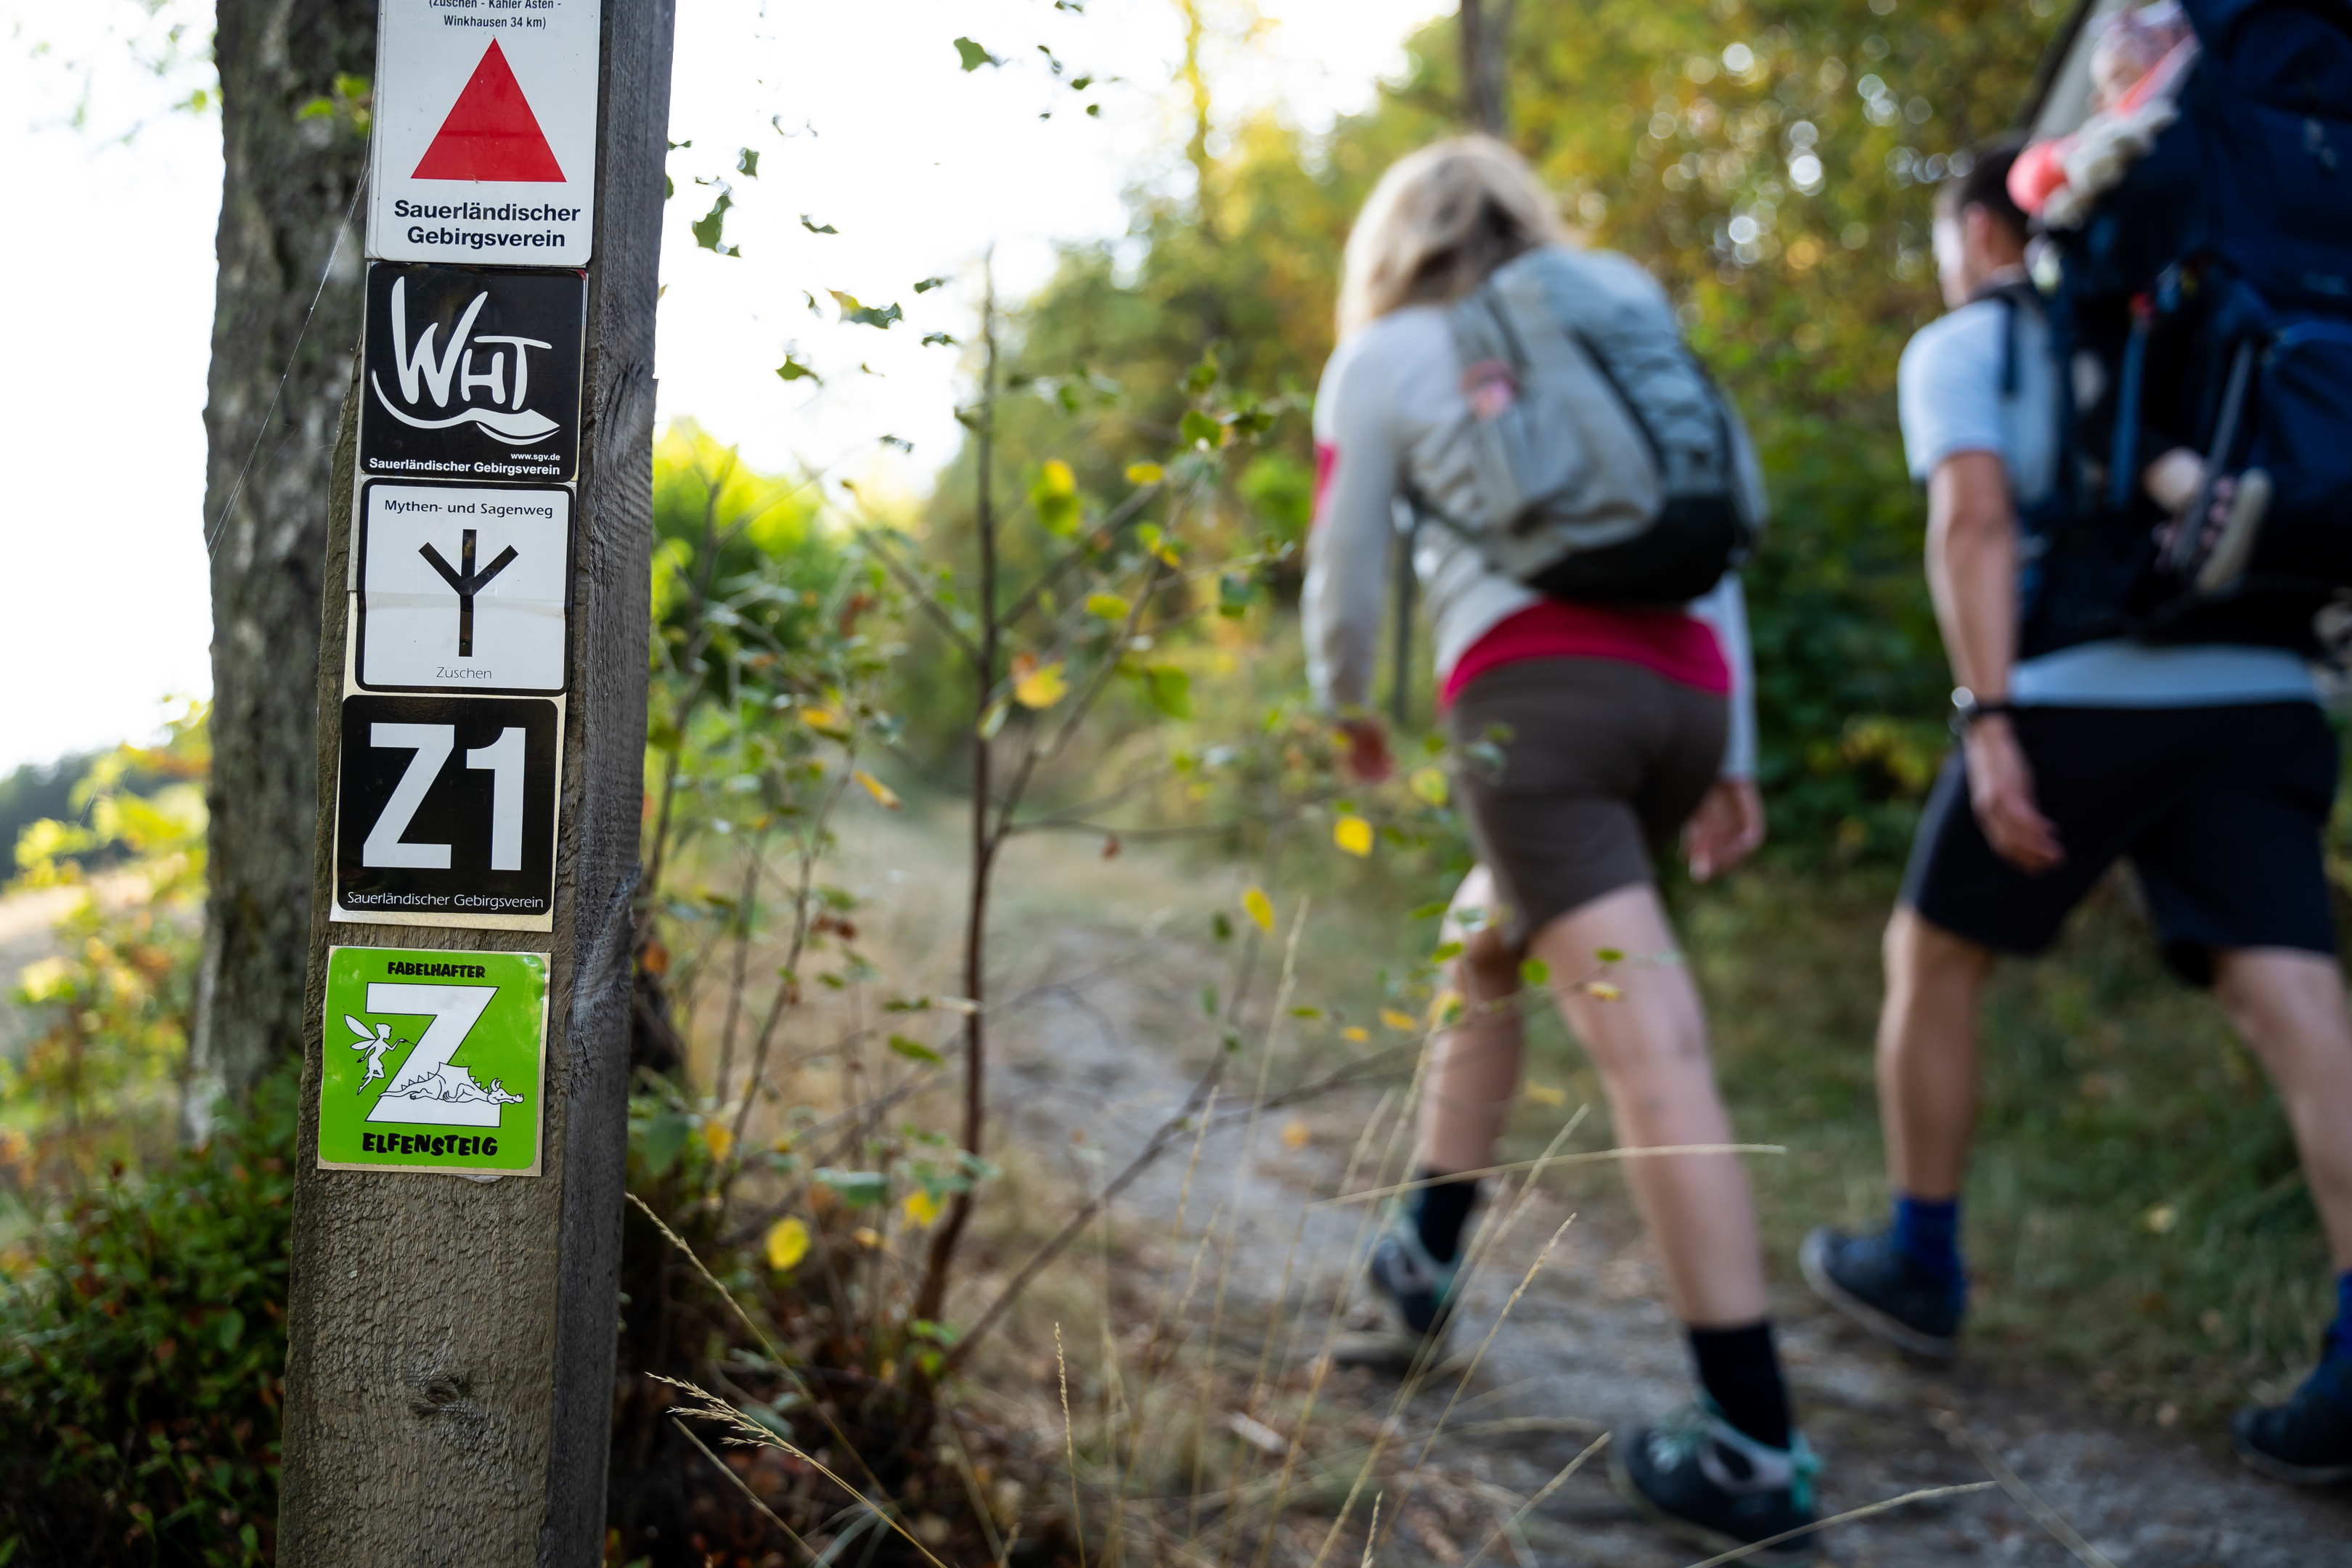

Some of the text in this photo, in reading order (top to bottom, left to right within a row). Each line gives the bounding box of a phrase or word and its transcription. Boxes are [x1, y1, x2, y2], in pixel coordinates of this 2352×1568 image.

[525, 0, 554, 9] Asten
[444, 15, 546, 29] Winkhausen 34 km)
[394, 200, 581, 221] Sauerländischer
[407, 226, 565, 249] Gebirgsverein
[369, 458, 560, 475] Sauerländischer Gebirgsverein
[385, 499, 553, 518] Mythen- und Sagenweg
[436, 666, 492, 679] Züschen
[363, 722, 526, 870] Z1
[347, 891, 544, 910] Sauerländischer Gebirgsverein
[387, 961, 486, 979] FABELHAFTER
[364, 981, 500, 1127] Z
[362, 1132, 498, 1156] ELFENSTEIG
